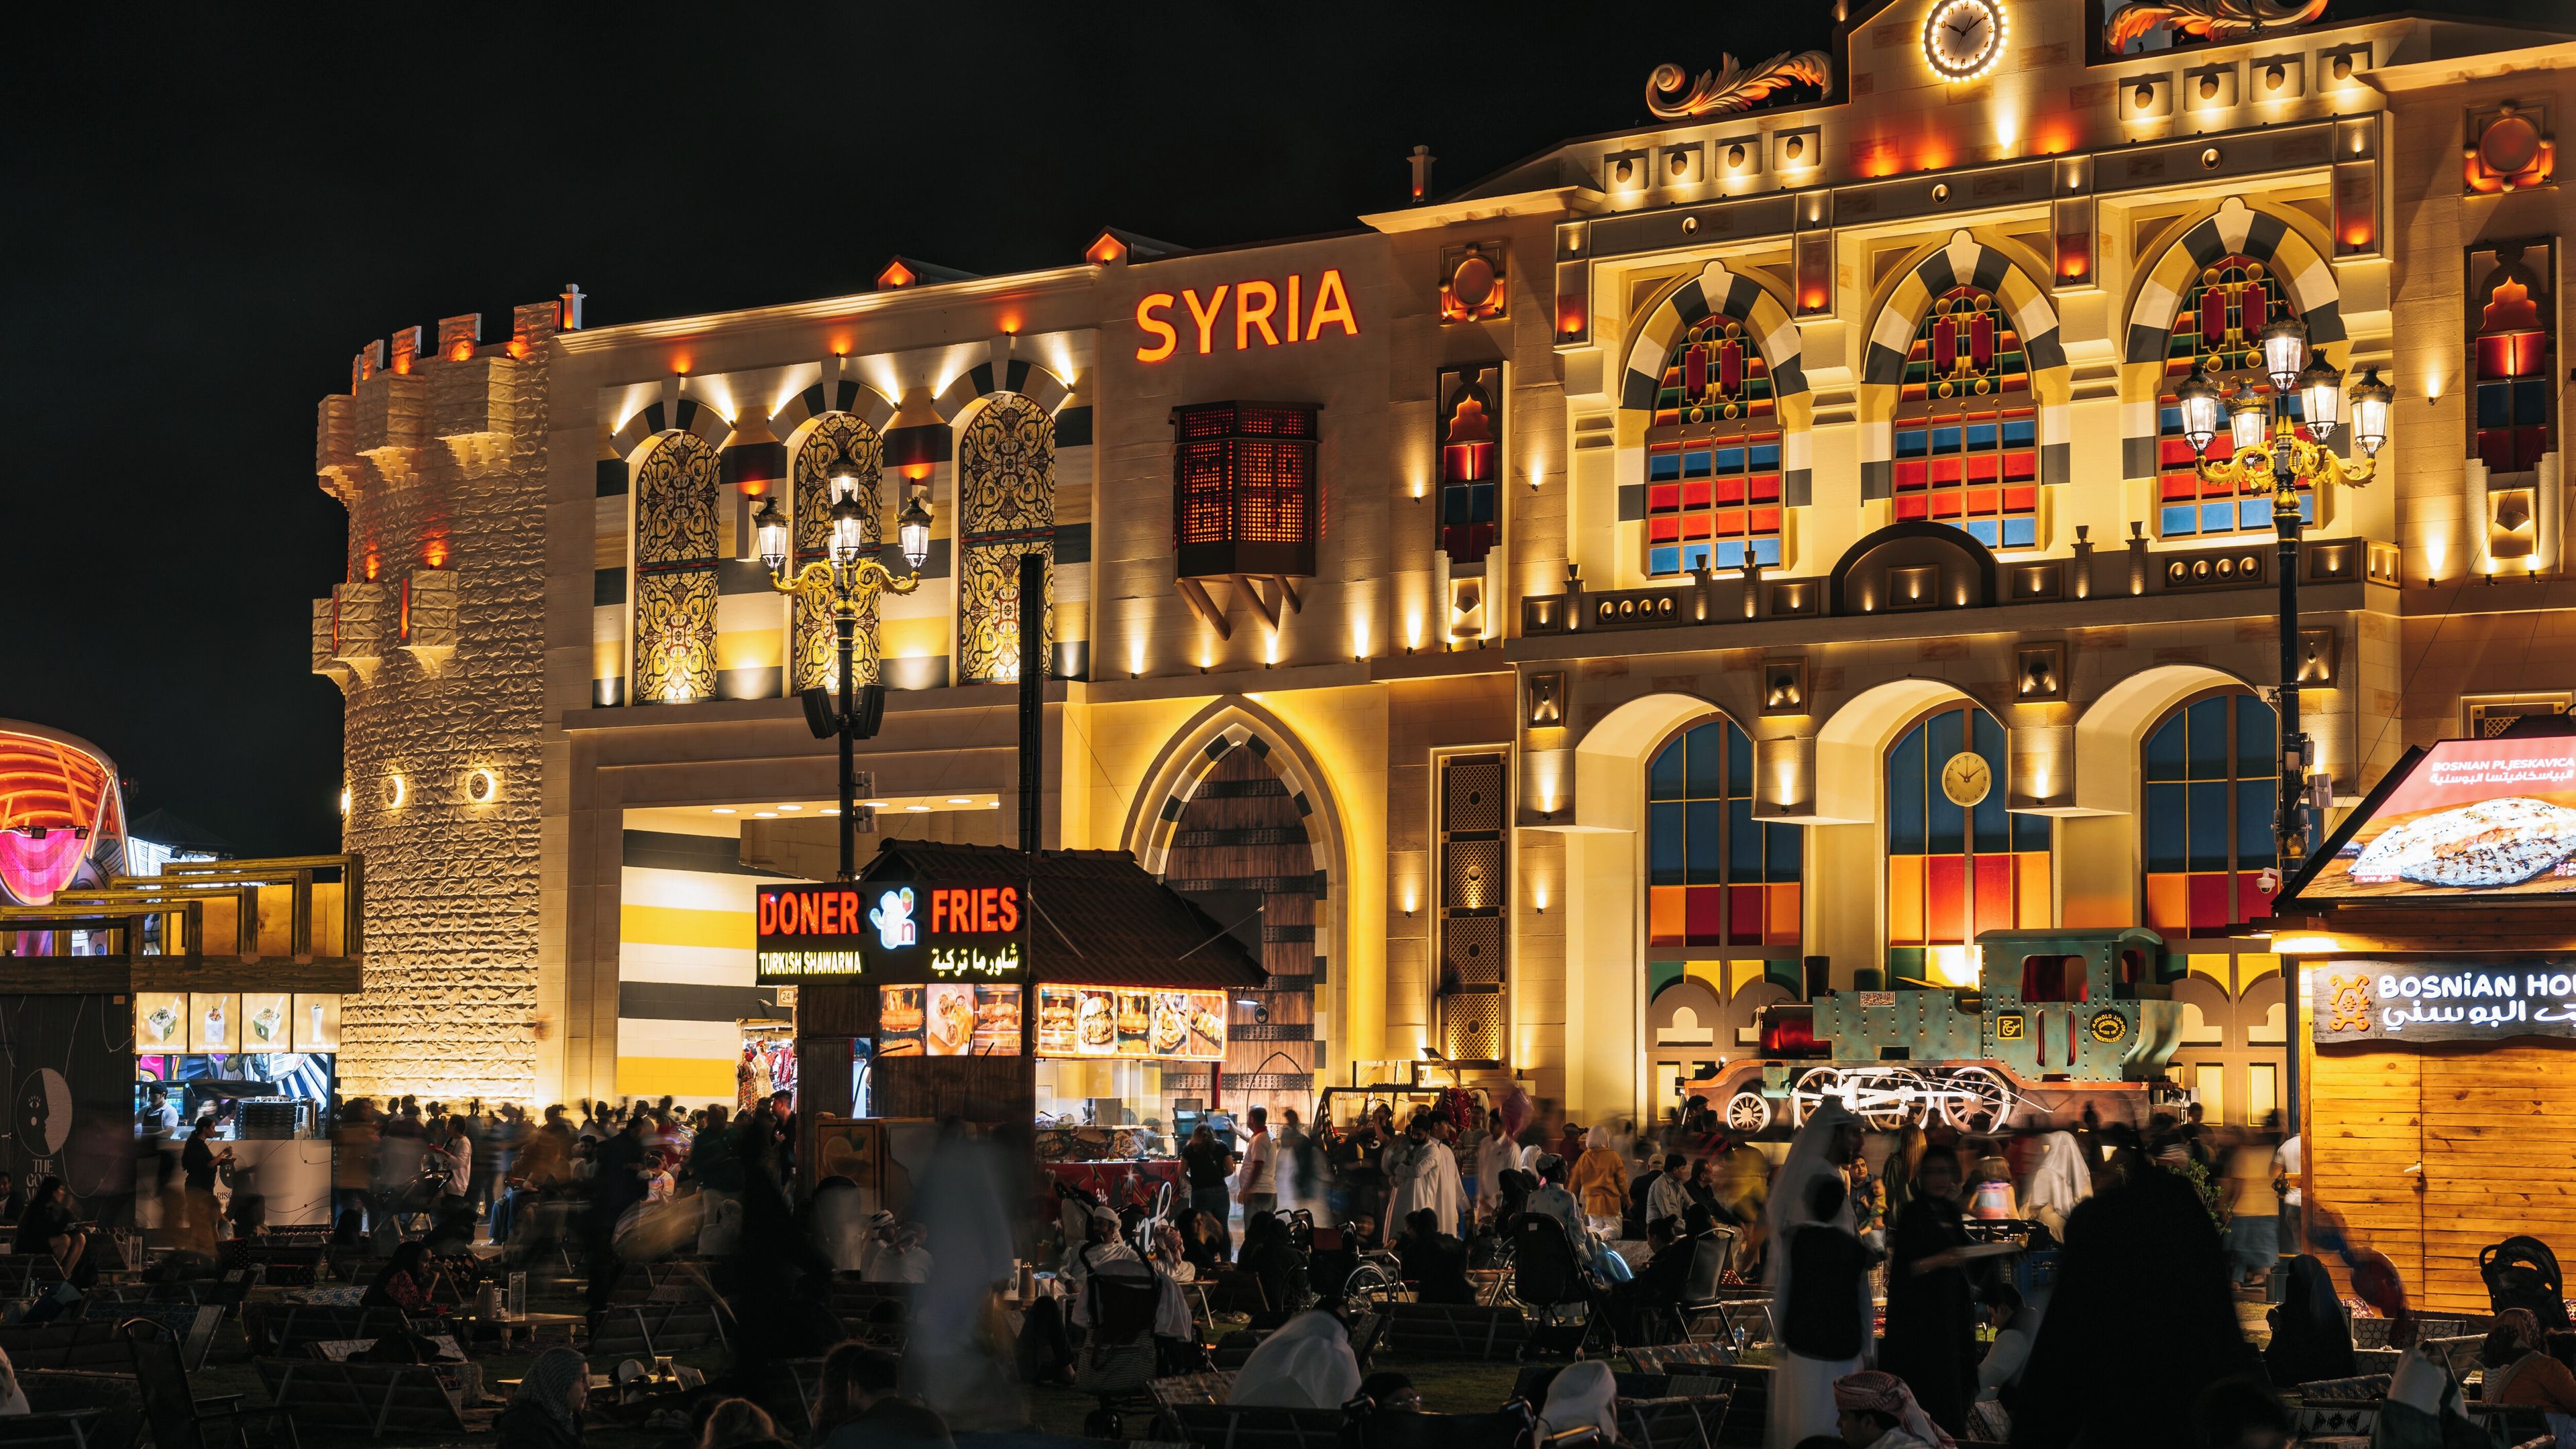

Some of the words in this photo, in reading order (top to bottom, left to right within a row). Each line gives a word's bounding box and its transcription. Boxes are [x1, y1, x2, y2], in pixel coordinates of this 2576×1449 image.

[1136, 269, 1360, 362] SYRIA
[2432, 761, 2490, 771] BOSNIAN
[2491, 757, 2575, 771] PLJESKAVICA
[2429, 773, 2484, 786] البوسنية
[759, 892, 859, 936] DONER
[932, 886, 1019, 933] FRIES
[759, 952, 802, 975] TURKISH
[803, 951, 862, 975] SHAWARMA
[931, 947, 968, 977] تركية
[972, 942, 1019, 977] شاورما
[782, 992, 790, 1001] 24
[2527, 973, 2576, 997] HO
[2382, 1000, 2526, 1031] البوسني
[1095, 1188, 1108, 1205] 34
